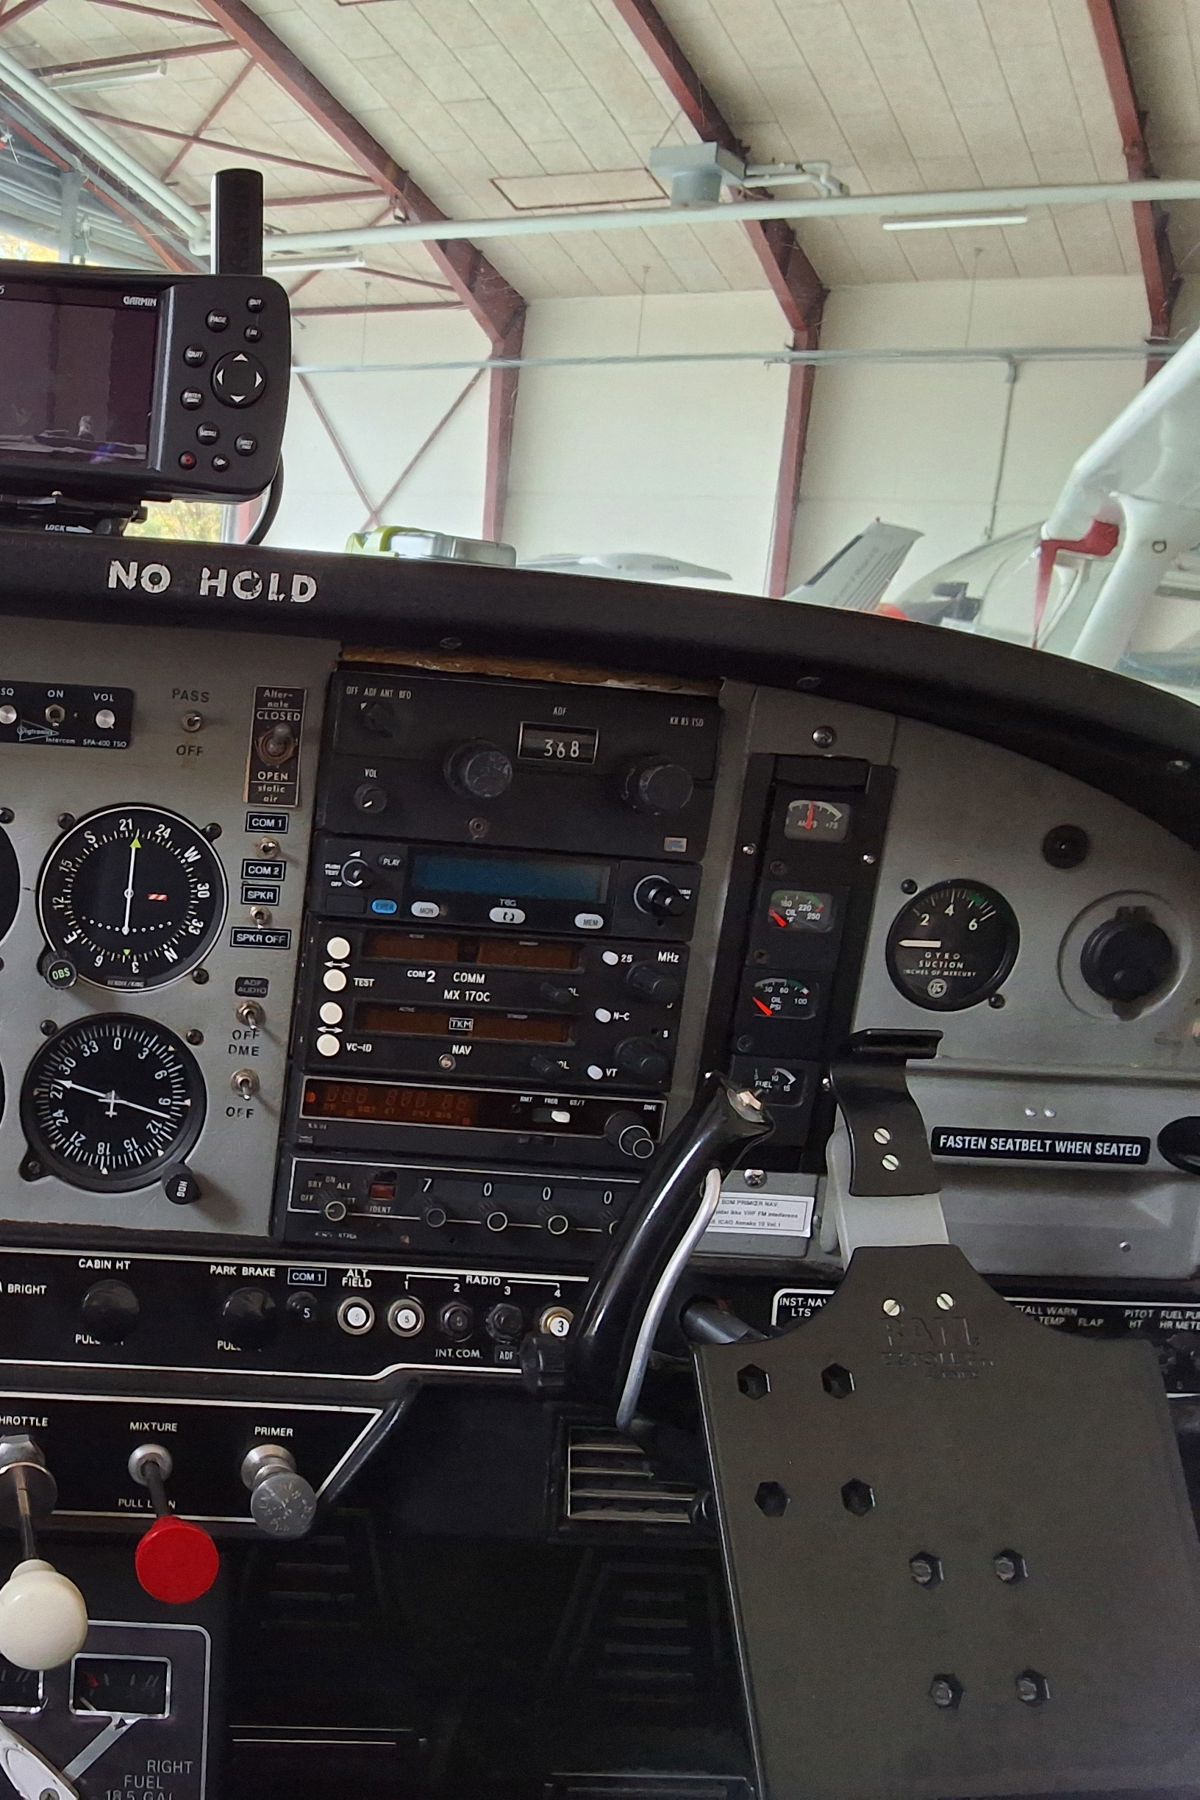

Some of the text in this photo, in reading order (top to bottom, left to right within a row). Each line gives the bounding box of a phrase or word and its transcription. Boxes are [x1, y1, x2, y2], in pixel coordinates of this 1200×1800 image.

[123, 296, 157, 306] GARMIN
[45, 523, 66, 533] LOCK
[108, 560, 317, 603] NO HOLD
[1, 687, 14, 697] SQ
[48, 689, 64, 698] ON
[93, 692, 114, 702] VOL
[171, 688, 210, 703] PASS
[263, 688, 293, 699] Alter-
[346, 685, 393, 698] OFF ADF ANT
[256, 710, 301, 721] CLOSED
[553, 706, 567, 717] ADF
[46, 737, 76, 745] Intercom
[176, 744, 204, 757] OFF
[544, 739, 580, 759] 368
[258, 771, 289, 781] OPEN
[365, 768, 377, 778] VOL
[258, 783, 286, 794] static
[263, 794, 278, 803] air
[252, 818, 282, 828] COM 1
[84, 830, 97, 845] S
[183, 845, 201, 864] W
[383, 858, 400, 866] PLAY
[248, 866, 279, 875] COM 2
[247, 889, 274, 901] SPKR
[419, 906, 434, 914] MON
[583, 919, 598, 927] MEM
[63, 930, 78, 945] E
[236, 933, 285, 944] SPKR OFF
[164, 947, 179, 963] N
[657, 951, 680, 963] MHz
[925, 951, 961, 960] GYRO
[919, 959, 964, 969] SUCTION
[52, 967, 71, 981] OBS
[407, 969, 437, 983] COM 2
[453, 971, 486, 984] COMM
[904, 968, 929, 976] INCHES
[353, 977, 375, 988] TEST
[443, 989, 491, 1002] MX 170C
[613, 1011, 630, 1021] N-C
[451, 1019, 473, 1030] TKM
[232, 1029, 261, 1041] OFF
[228, 1044, 260, 1057] DME
[346, 1042, 372, 1053] VC-ID
[452, 1044, 472, 1056] NAV
[606, 1068, 618, 1077] VT
[755, 1080, 772, 1089] FUEL
[226, 1106, 254, 1119] OFF
[939, 1134, 1142, 1157] FASTEN SEATBELT WHEN SEATED
[176, 1180, 188, 1198] HDG
[336, 1182, 351, 1190] ALT
[369, 1206, 392, 1214] IDENT
[78, 1258, 131, 1271] CABIN HT
[210, 1264, 276, 1278] PARK BRAKE
[346, 1268, 369, 1278] ALT
[292, 1272, 322, 1282] COM 1
[341, 1277, 373, 1288] FIELD
[465, 1274, 501, 1286] RADIO
[7, 1283, 47, 1296] BRIGHT
[791, 1308, 811, 1317] LTS
[1047, 1307, 1078, 1317] WARN
[1124, 1309, 1154, 1319] PITOT
[1160, 1310, 1183, 1320] FUEL
[1039, 1316, 1065, 1326] TEMP
[1078, 1318, 1104, 1327] FLAP
[1129, 1320, 1143, 1328] HT
[1159, 1321, 1173, 1330] HR
[500, 1350, 514, 1361] ADF
[129, 1421, 179, 1433] MIXTURE
[254, 1426, 294, 1437] PRIMER
[118, 1498, 144, 1508] PULL
[147, 1759, 193, 1775] RIGHT
[124, 1774, 165, 1789] FUEL
[142, 1791, 174, 1800] GAL
